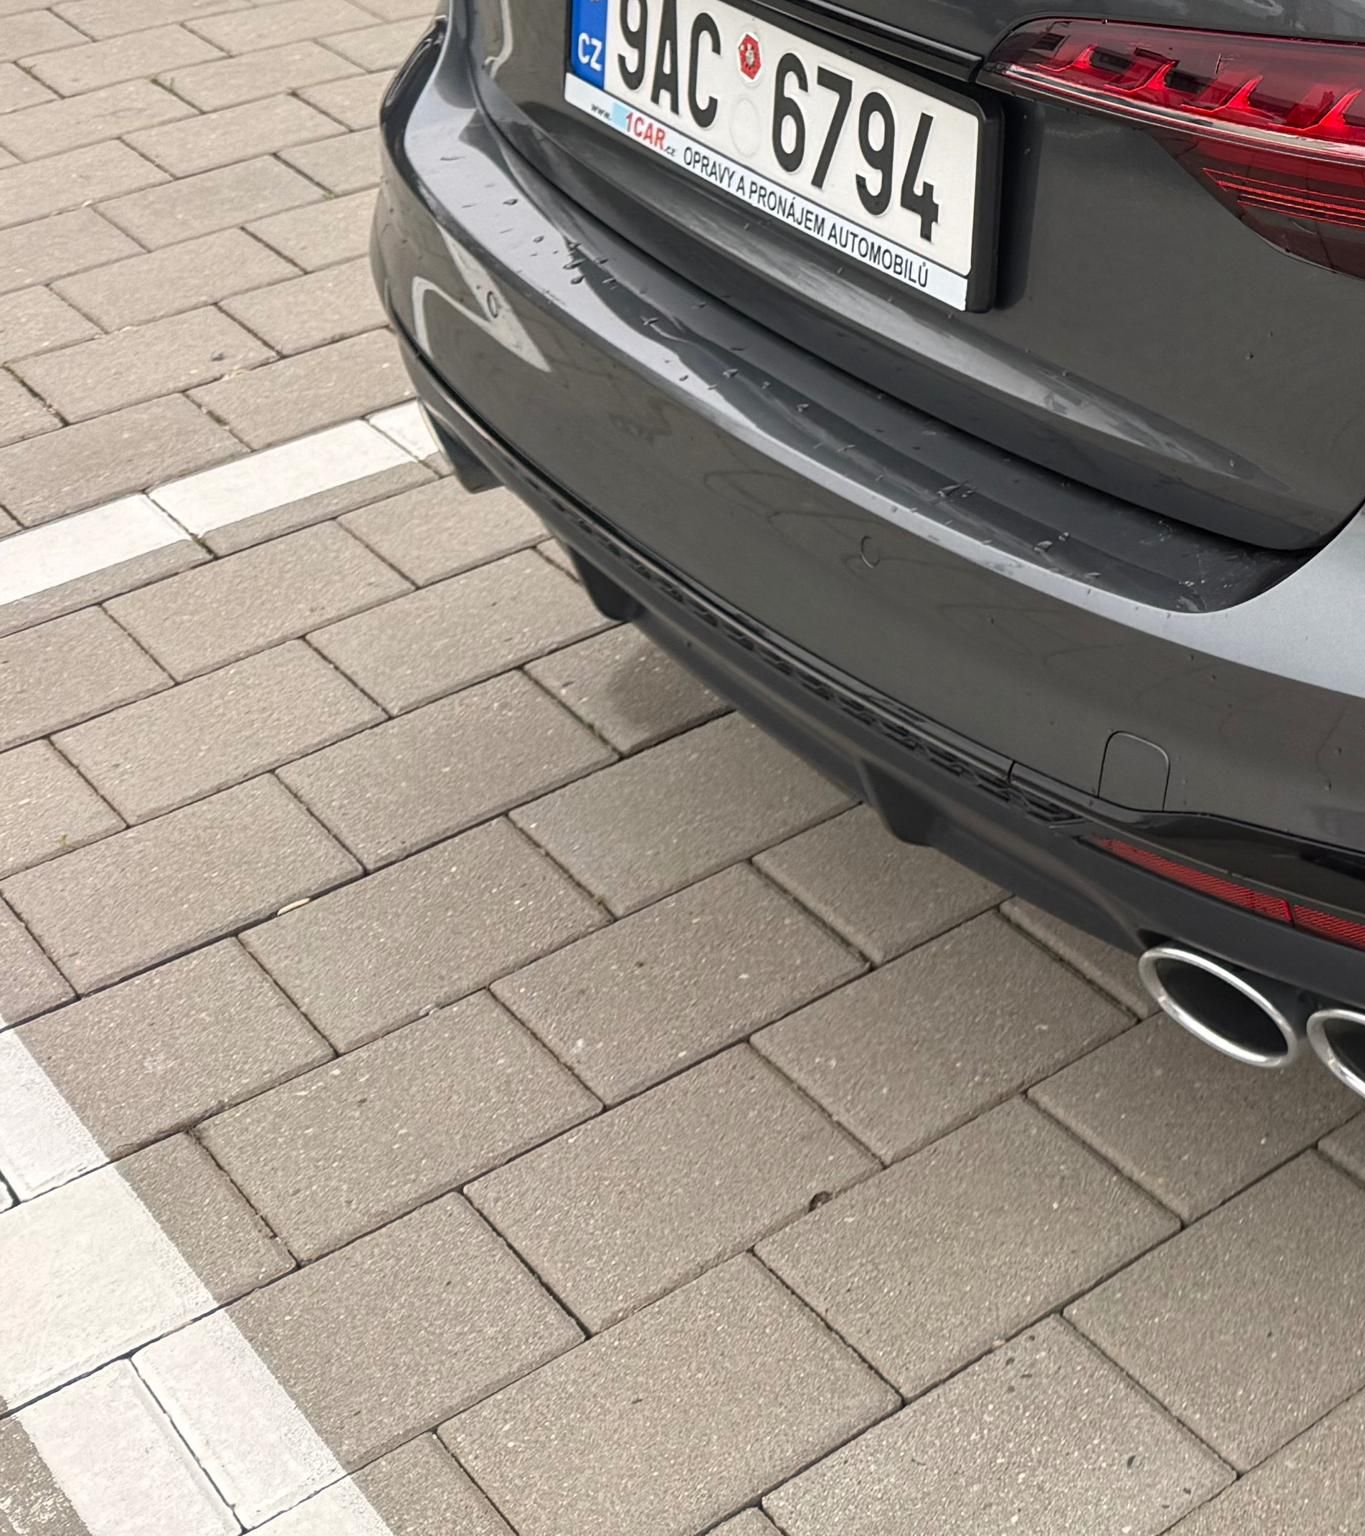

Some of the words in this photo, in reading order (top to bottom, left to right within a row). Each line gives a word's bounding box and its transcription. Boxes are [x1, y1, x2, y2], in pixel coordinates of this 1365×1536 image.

[577, 32, 603, 72] CZ
[684, 147, 735, 188] OPRAVY
[736, 175, 746, 196] A
[749, 181, 825, 238] PRONÁJEM
[828, 222, 929, 288] AUTOMOBILŮ
[772, 52, 940, 242] 6794
